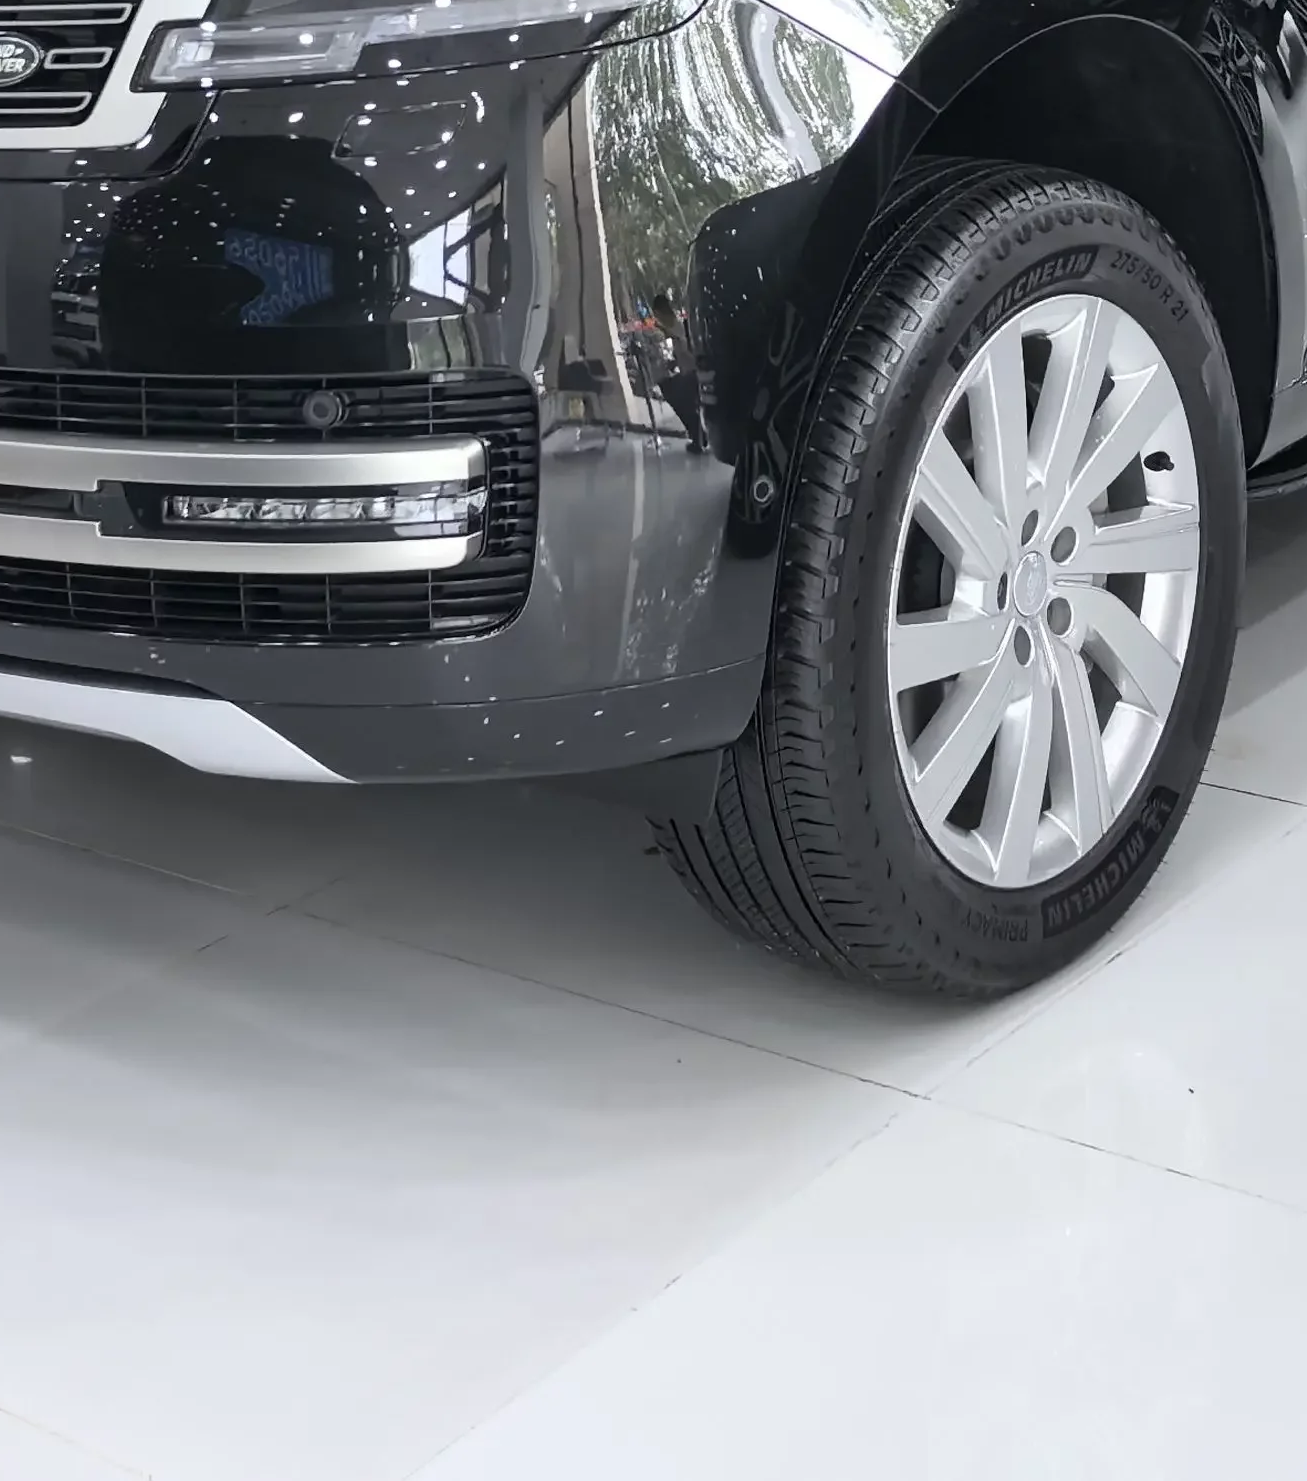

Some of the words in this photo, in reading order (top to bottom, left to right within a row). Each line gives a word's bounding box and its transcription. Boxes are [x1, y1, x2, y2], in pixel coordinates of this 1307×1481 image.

[984, 251, 1092, 328] MICHELIN
[1110, 249, 1163, 290] 275/50
[1159, 285, 1174, 304] R
[1170, 300, 1189, 323] 21
[1047, 829, 1146, 928] MICHELIN
